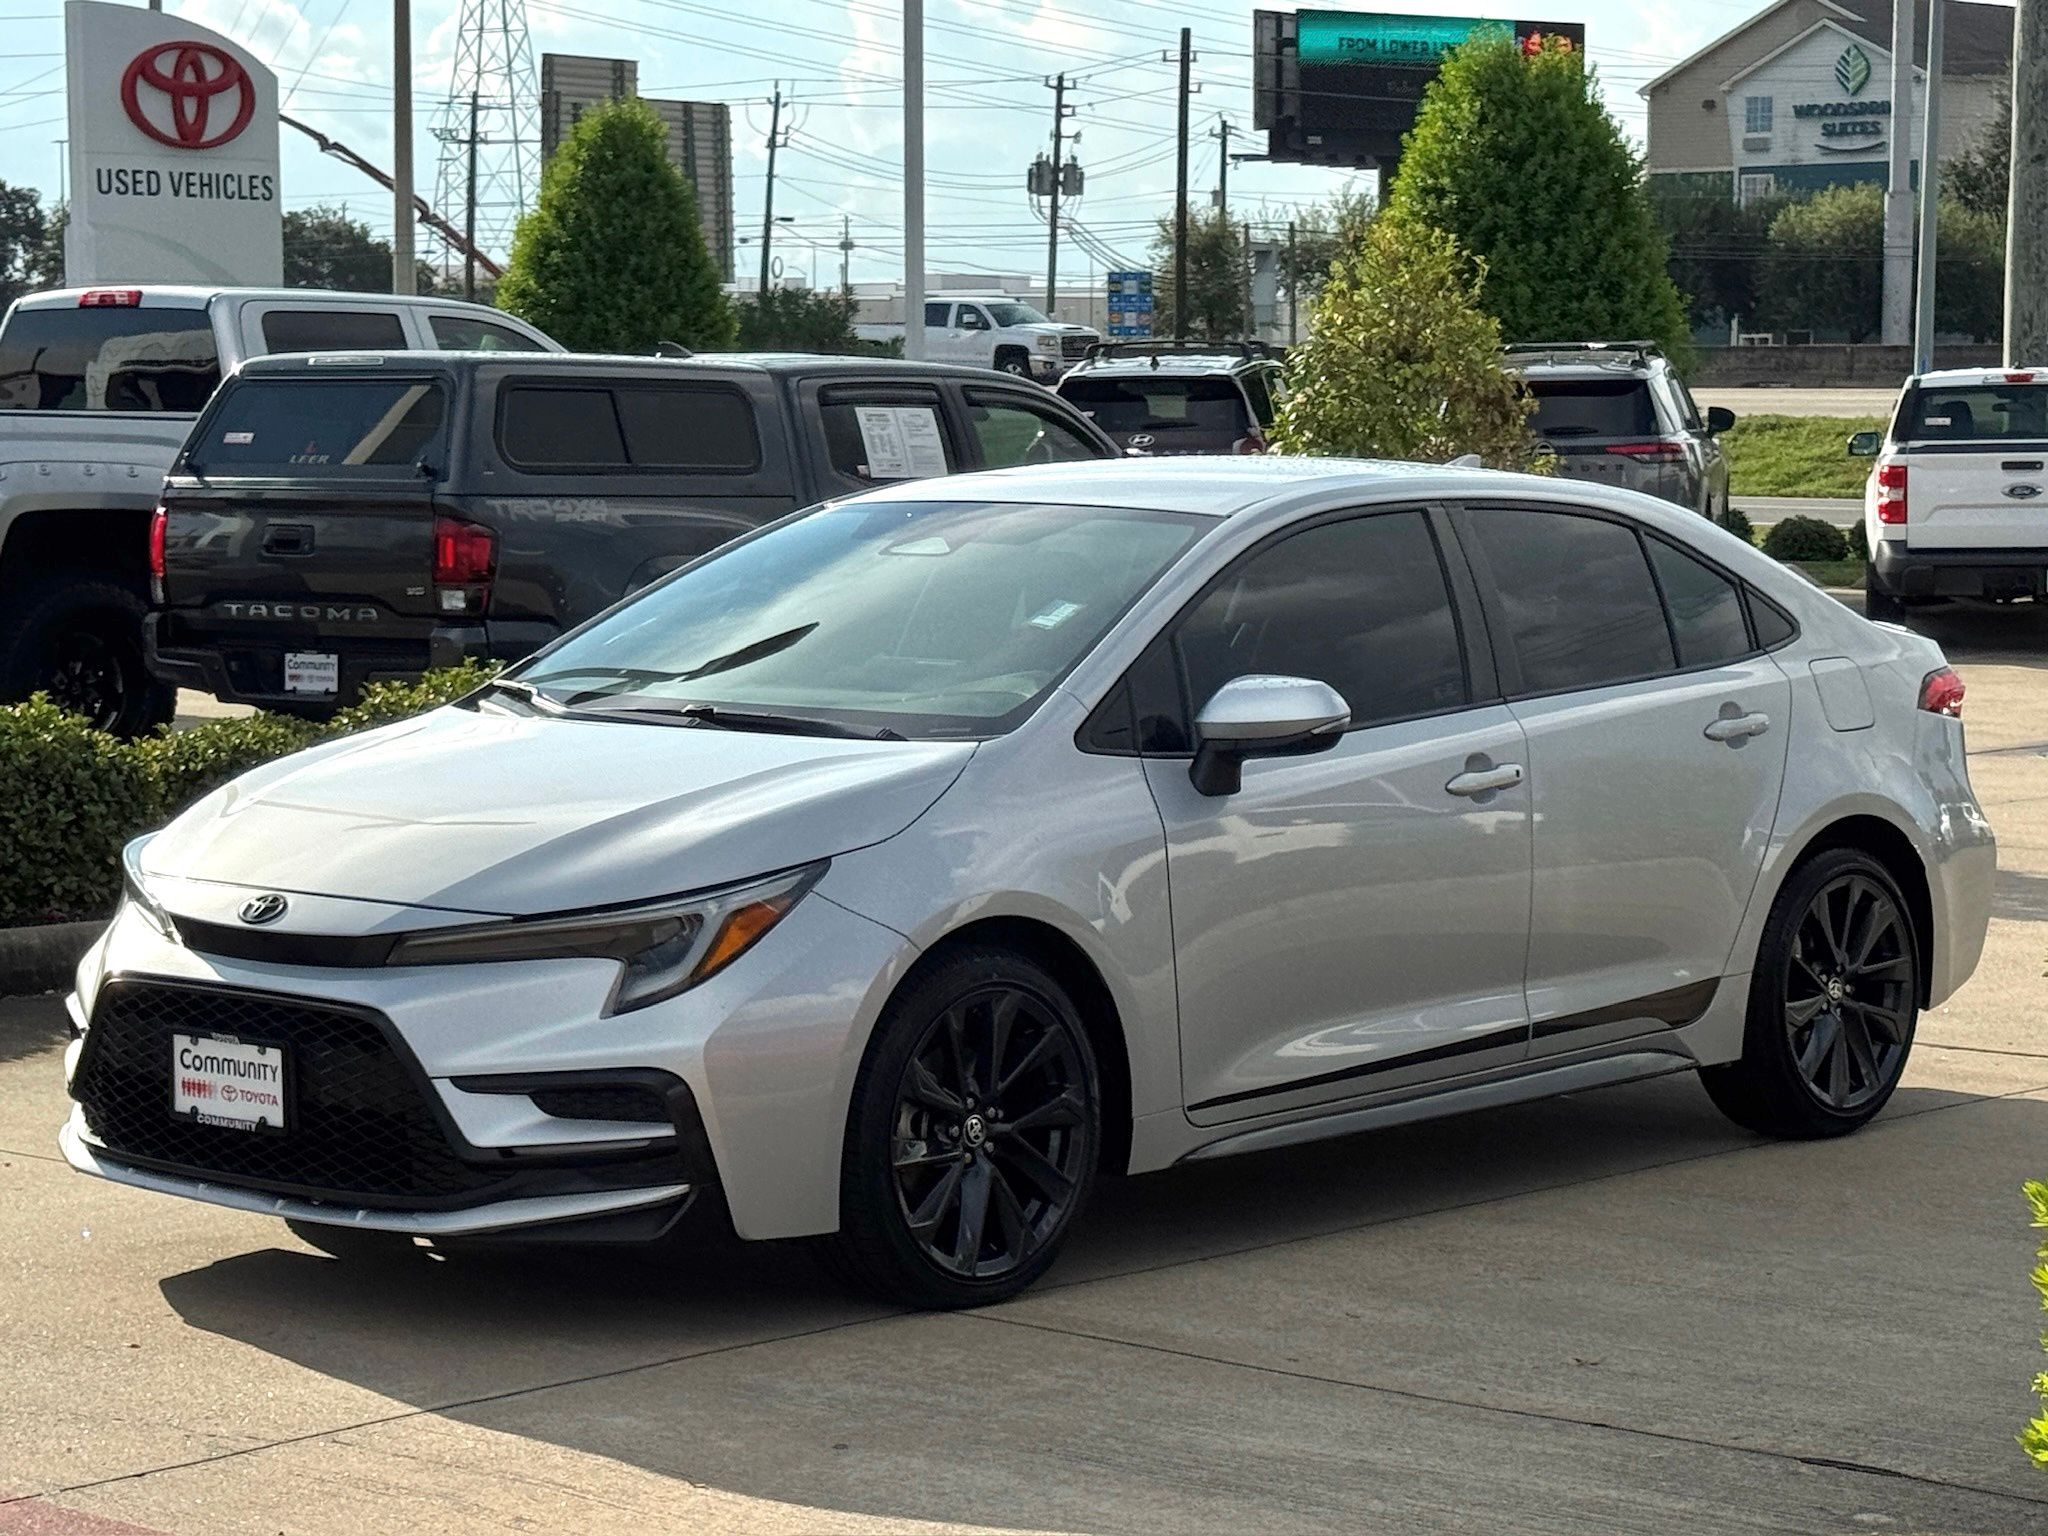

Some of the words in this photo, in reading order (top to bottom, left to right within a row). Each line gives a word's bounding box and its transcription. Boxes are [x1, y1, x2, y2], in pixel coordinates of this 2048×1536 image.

[1338, 37, 1377, 52] FROM
[96, 168, 161, 196] USED
[168, 171, 273, 201] VEHICLES
[224, 604, 378, 620] TACOMA
[239, 1089, 279, 1106] TOYOTA
[197, 1113, 257, 1132] COMMUNITY
